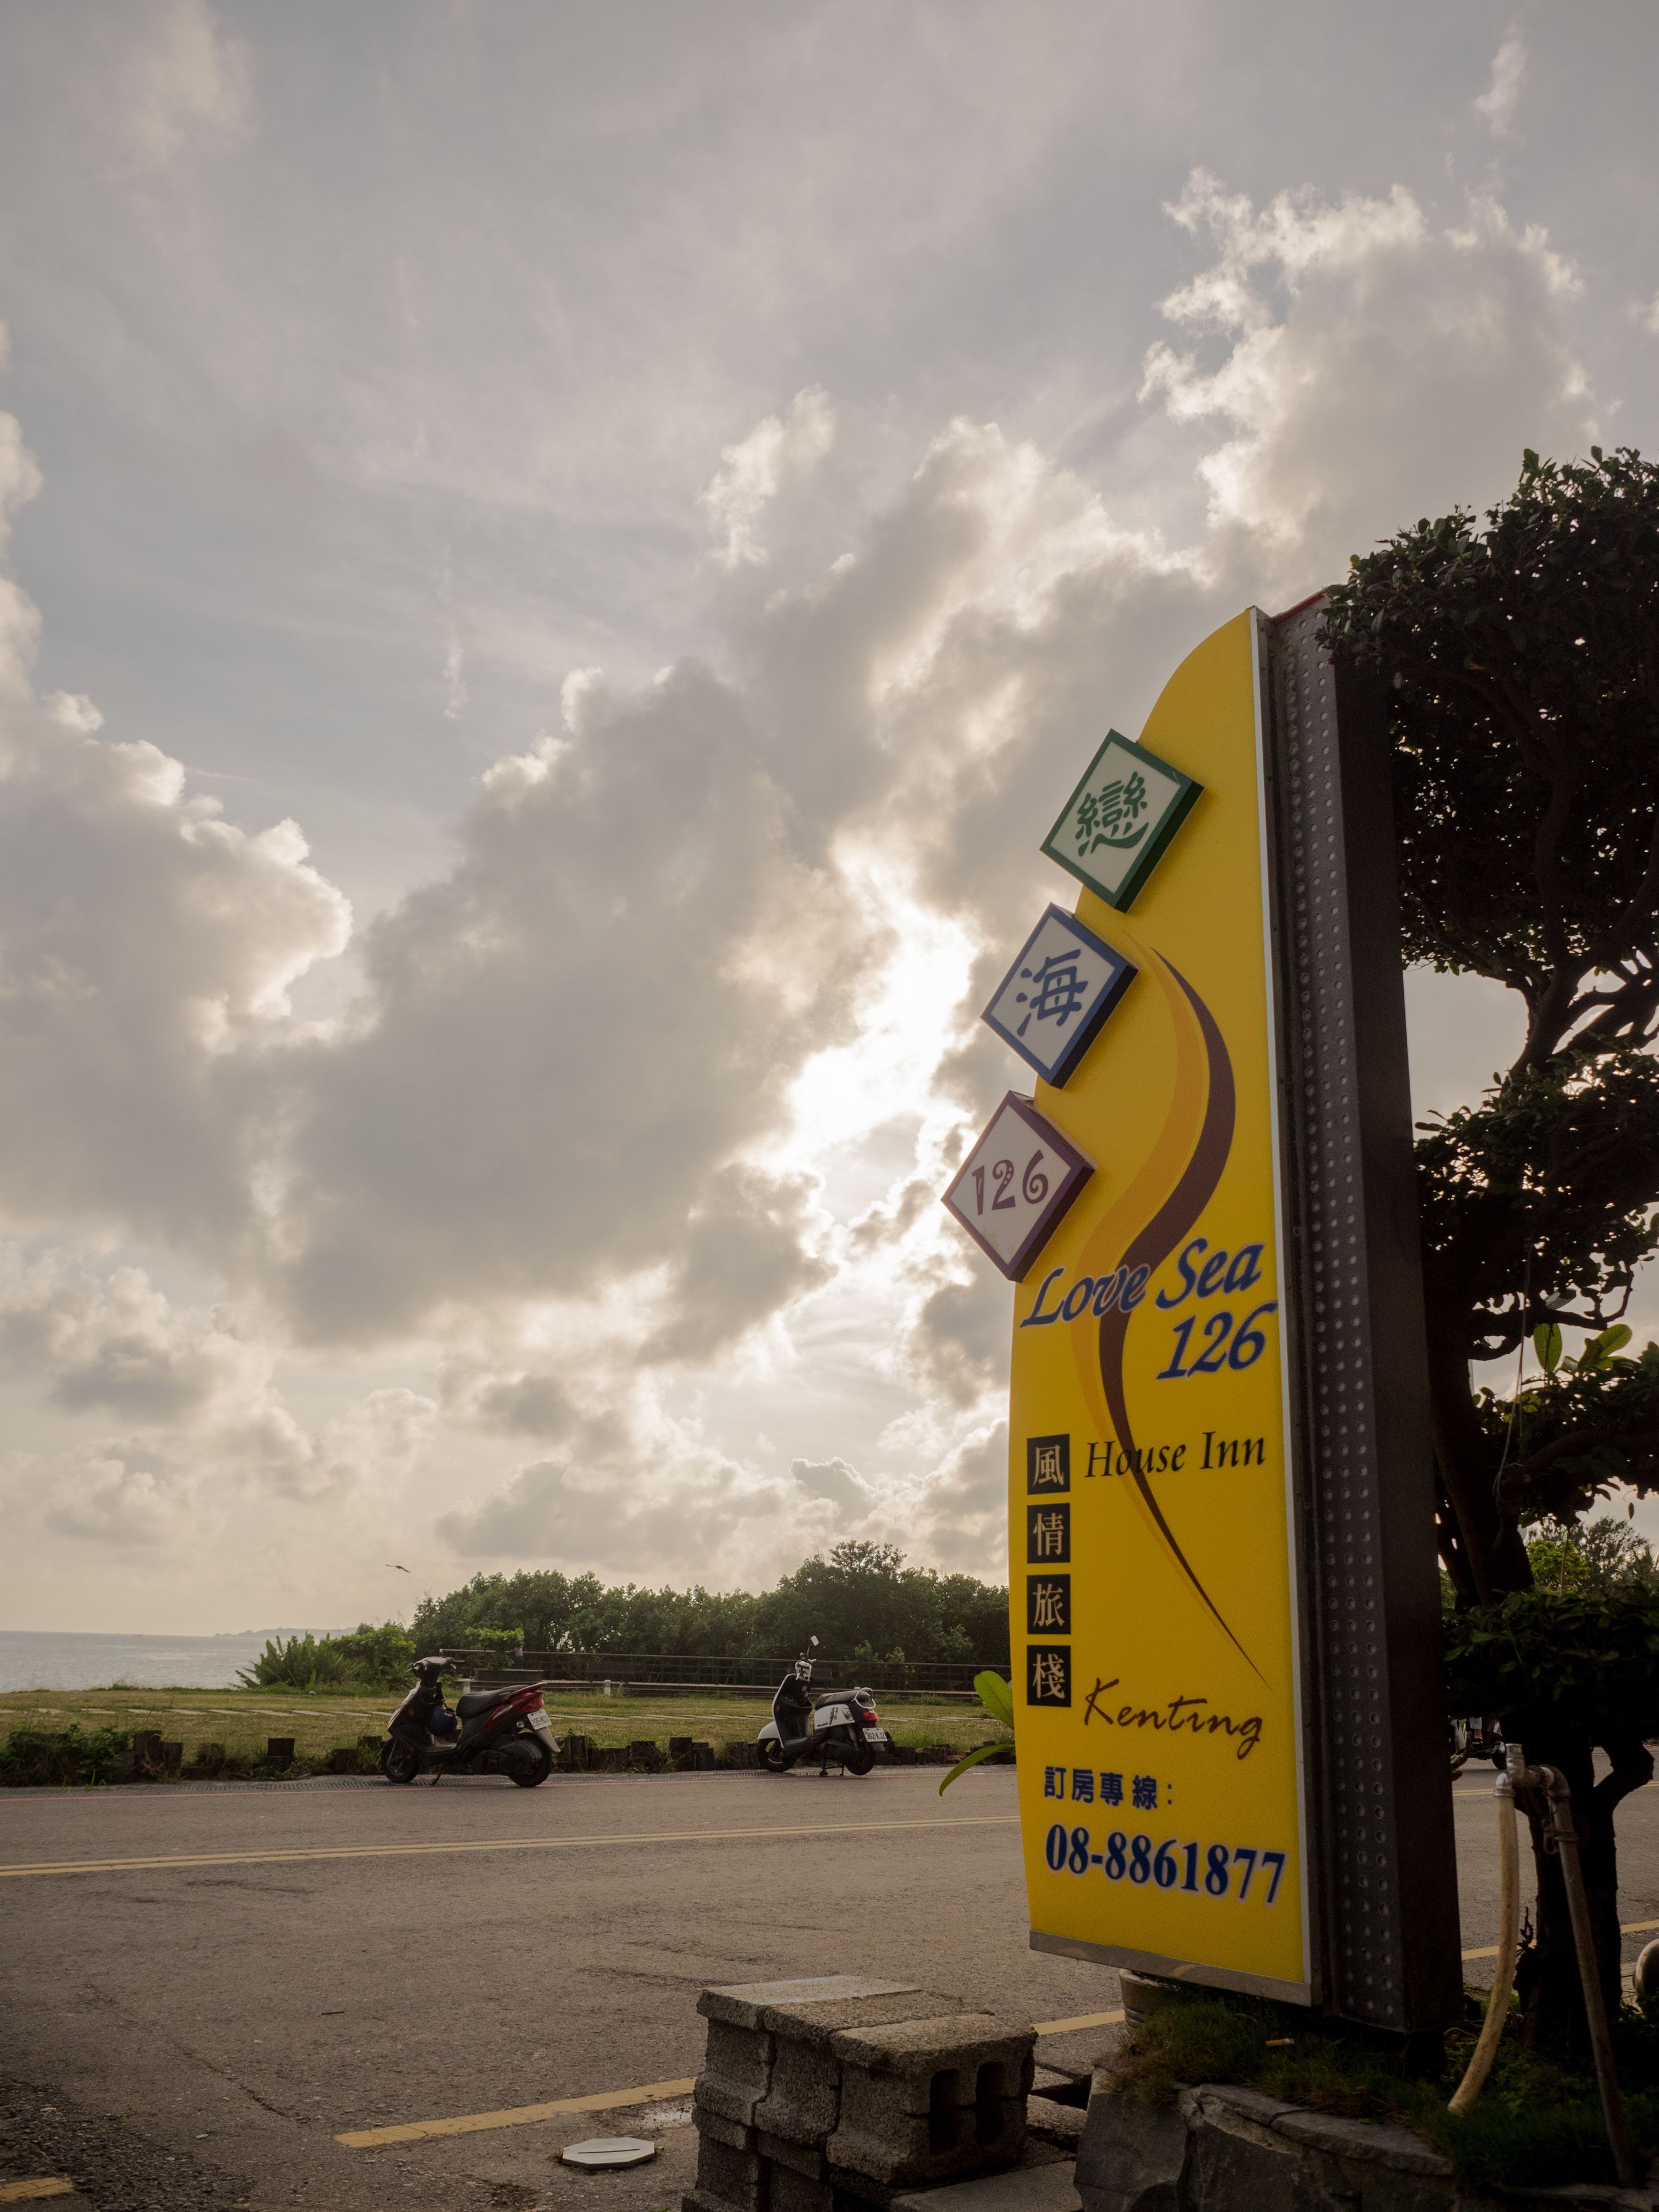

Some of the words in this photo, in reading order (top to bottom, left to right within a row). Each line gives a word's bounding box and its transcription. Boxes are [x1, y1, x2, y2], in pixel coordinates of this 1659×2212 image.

[1075, 771, 1150, 857] 戀
[1016, 949, 1088, 1037] 海
[971, 1149, 1049, 1217] 126
[1018, 1263, 1152, 1329] Love
[1154, 1237, 1267, 1311] Sea
[1156, 1300, 1279, 1380] 126
[1084, 1441, 1187, 1478] House
[1199, 1431, 1266, 1470] Inn
[1084, 1677, 1263, 1760] Kenting
[1045, 1823, 1286, 1906] 08-8861877
